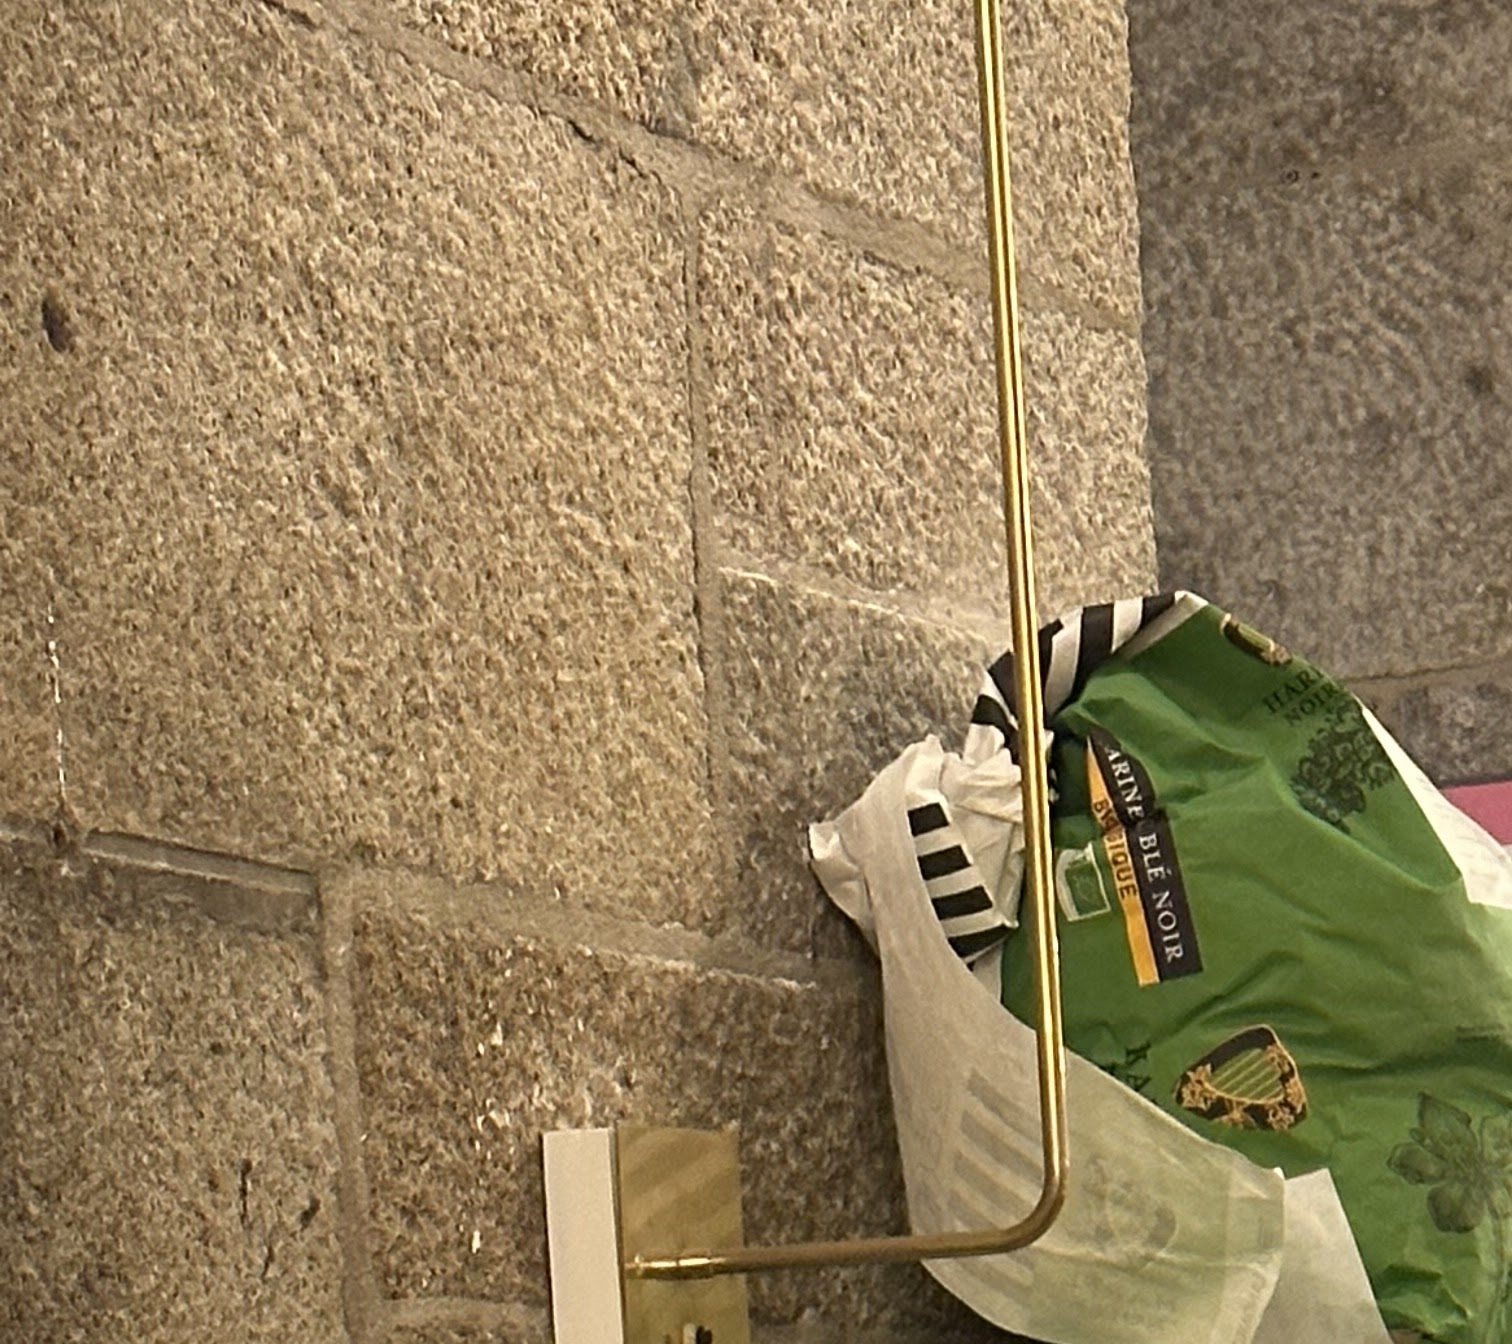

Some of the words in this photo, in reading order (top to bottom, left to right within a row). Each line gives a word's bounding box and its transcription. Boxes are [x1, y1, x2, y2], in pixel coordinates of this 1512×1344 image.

[1105, 745, 1145, 820] ARINE
[1139, 832, 1171, 883] BLÉ
[1152, 890, 1184, 963] NOIR
